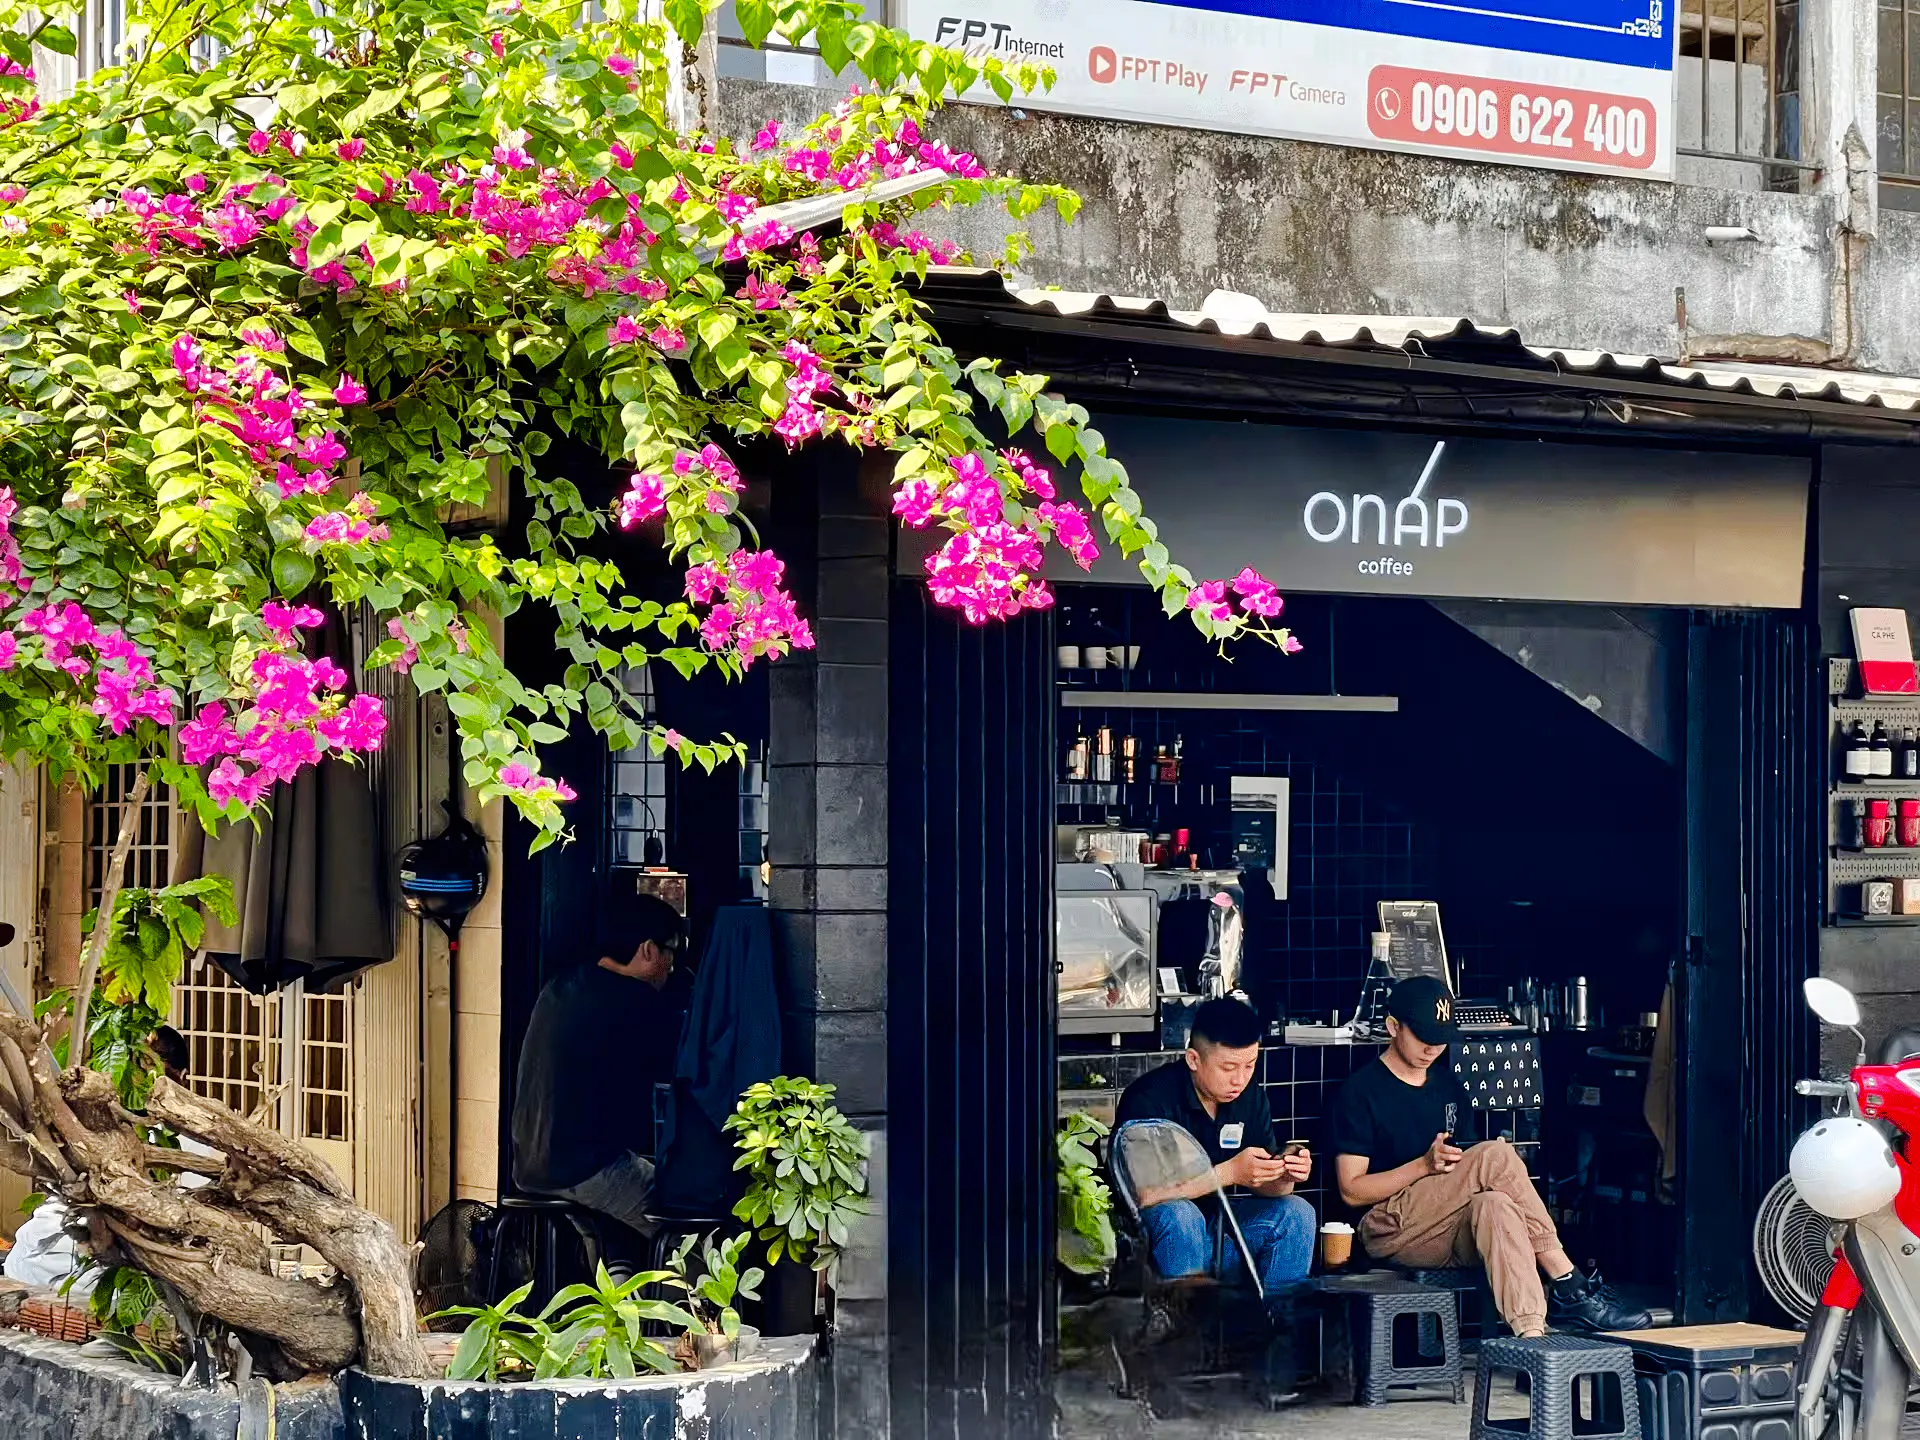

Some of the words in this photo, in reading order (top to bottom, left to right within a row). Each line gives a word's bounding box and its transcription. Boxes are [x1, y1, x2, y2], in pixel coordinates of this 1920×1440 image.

[935, 16, 1012, 50] FPT
[1005, 34, 1065, 59] Internet
[1121, 56, 1161, 83] FPT
[1165, 64, 1209, 95] Play
[1229, 69, 1290, 98] FPT
[1289, 81, 1346, 107] Camera
[1411, 81, 1499, 140] 0906
[1509, 94, 1574, 149] 622
[1583, 103, 1647, 158] 400
[1358, 557, 1414, 576] coffee
